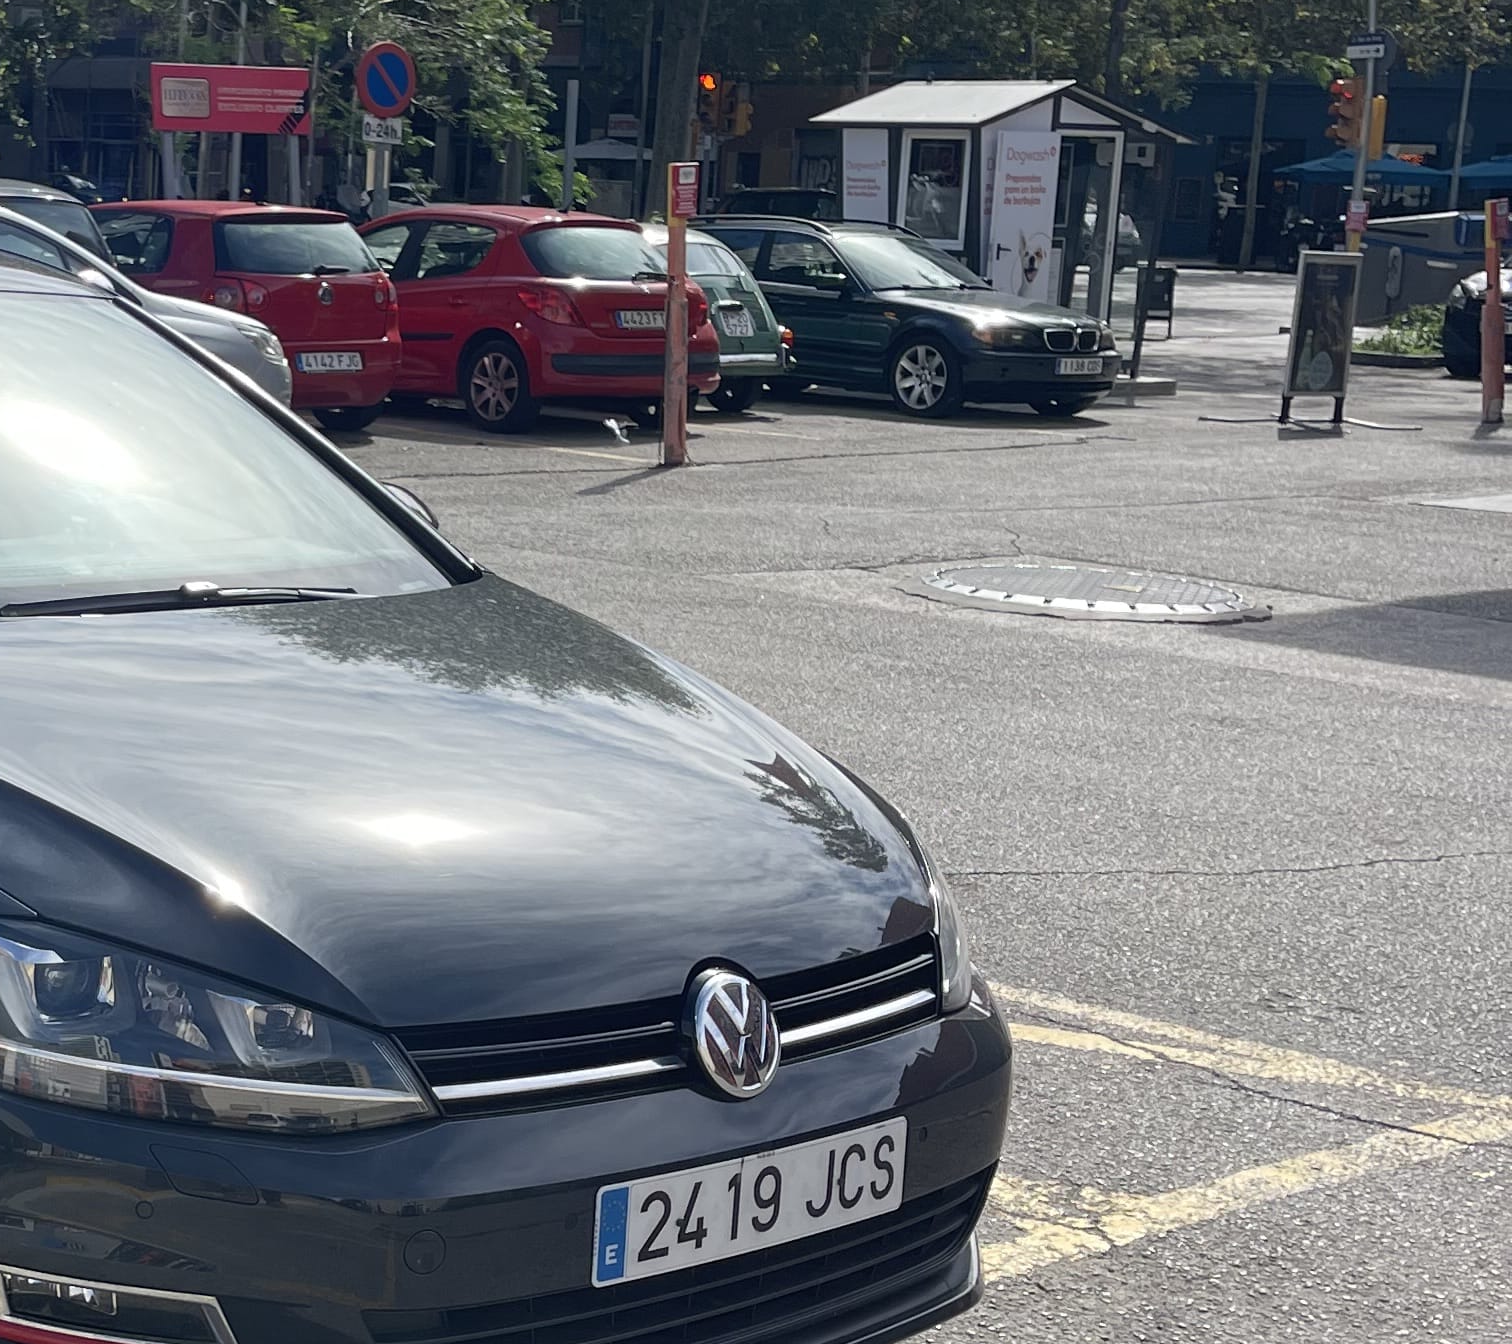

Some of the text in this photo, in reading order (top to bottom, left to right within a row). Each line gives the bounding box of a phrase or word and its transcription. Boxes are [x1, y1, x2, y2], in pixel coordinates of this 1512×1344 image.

[1007, 147, 1050, 164] Dogwash
[623, 311, 651, 325] 4423
[305, 354, 335, 369] 4142
[605, 1244, 619, 1265] E
[637, 1165, 782, 1263] 2419
[805, 1135, 895, 1218] JCS
